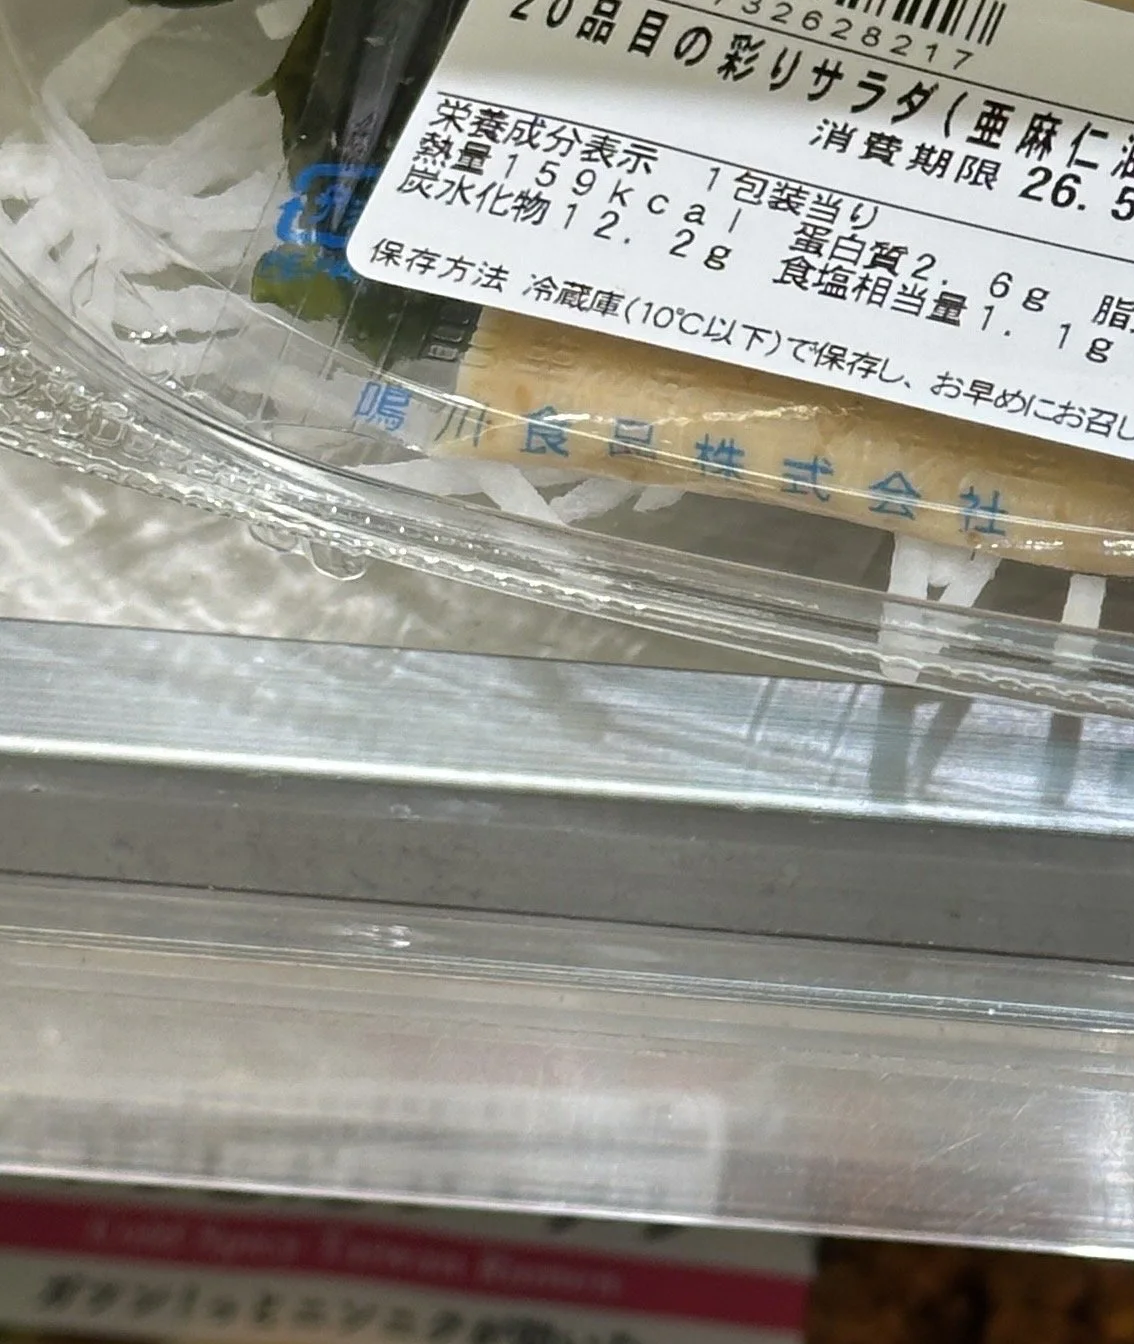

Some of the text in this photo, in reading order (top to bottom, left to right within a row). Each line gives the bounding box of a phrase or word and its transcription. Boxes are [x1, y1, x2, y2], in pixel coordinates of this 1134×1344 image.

[428, 97, 880, 232] 栄養成分表示 1包装当り
[808, 116, 1000, 193] 消費期限
[370, 237, 510, 294] 保存方法
[354, 380, 1008, 538] 鳴川食品株式会社
